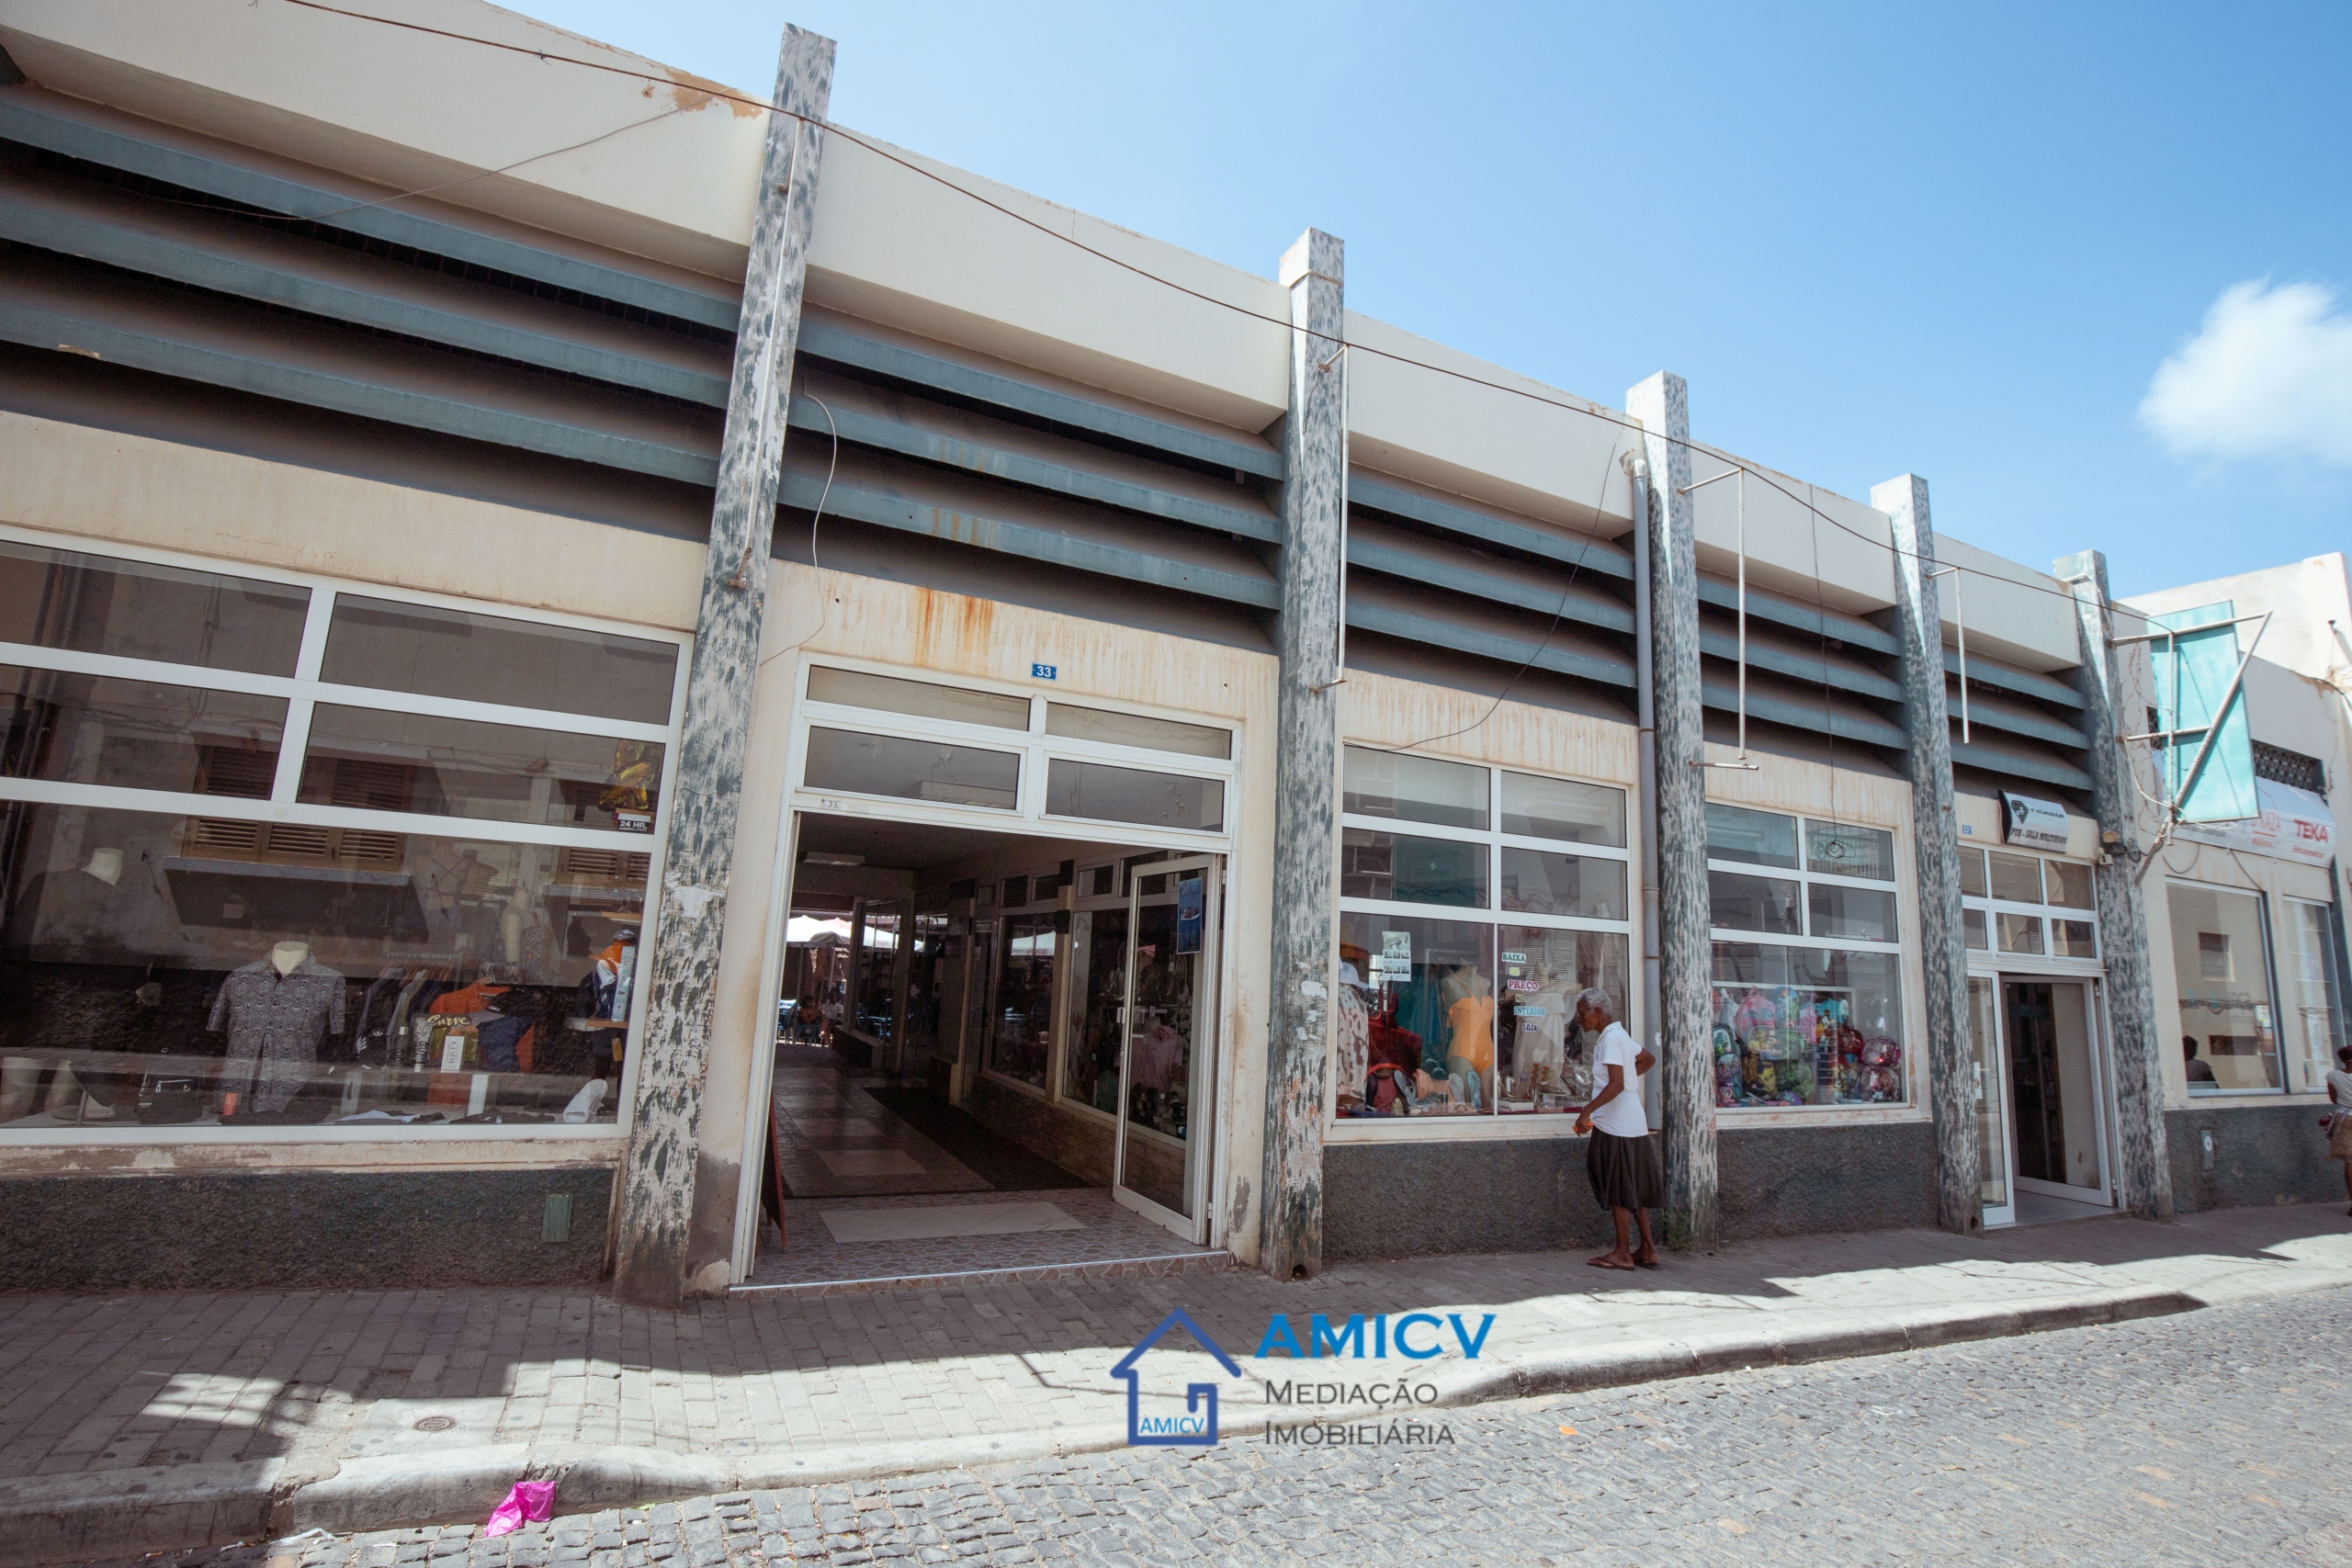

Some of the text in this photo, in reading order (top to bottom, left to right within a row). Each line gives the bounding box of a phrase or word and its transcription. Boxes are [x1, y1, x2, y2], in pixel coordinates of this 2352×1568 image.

[1036, 665, 1052, 678] 33
[2010, 828, 2022, 838] PUB
[2026, 829, 2039, 840] SALA
[2040, 832, 2068, 845] MULTIUSOS
[2293, 818, 2329, 843] TEKA
[1502, 953, 1525, 962] BAIXA
[1508, 980, 1538, 992] PREÇO
[1514, 1007, 1545, 1016] INTERIOR
[427, 1014, 470, 1027] Curve
[1523, 1023, 1537, 1032] LOJA
